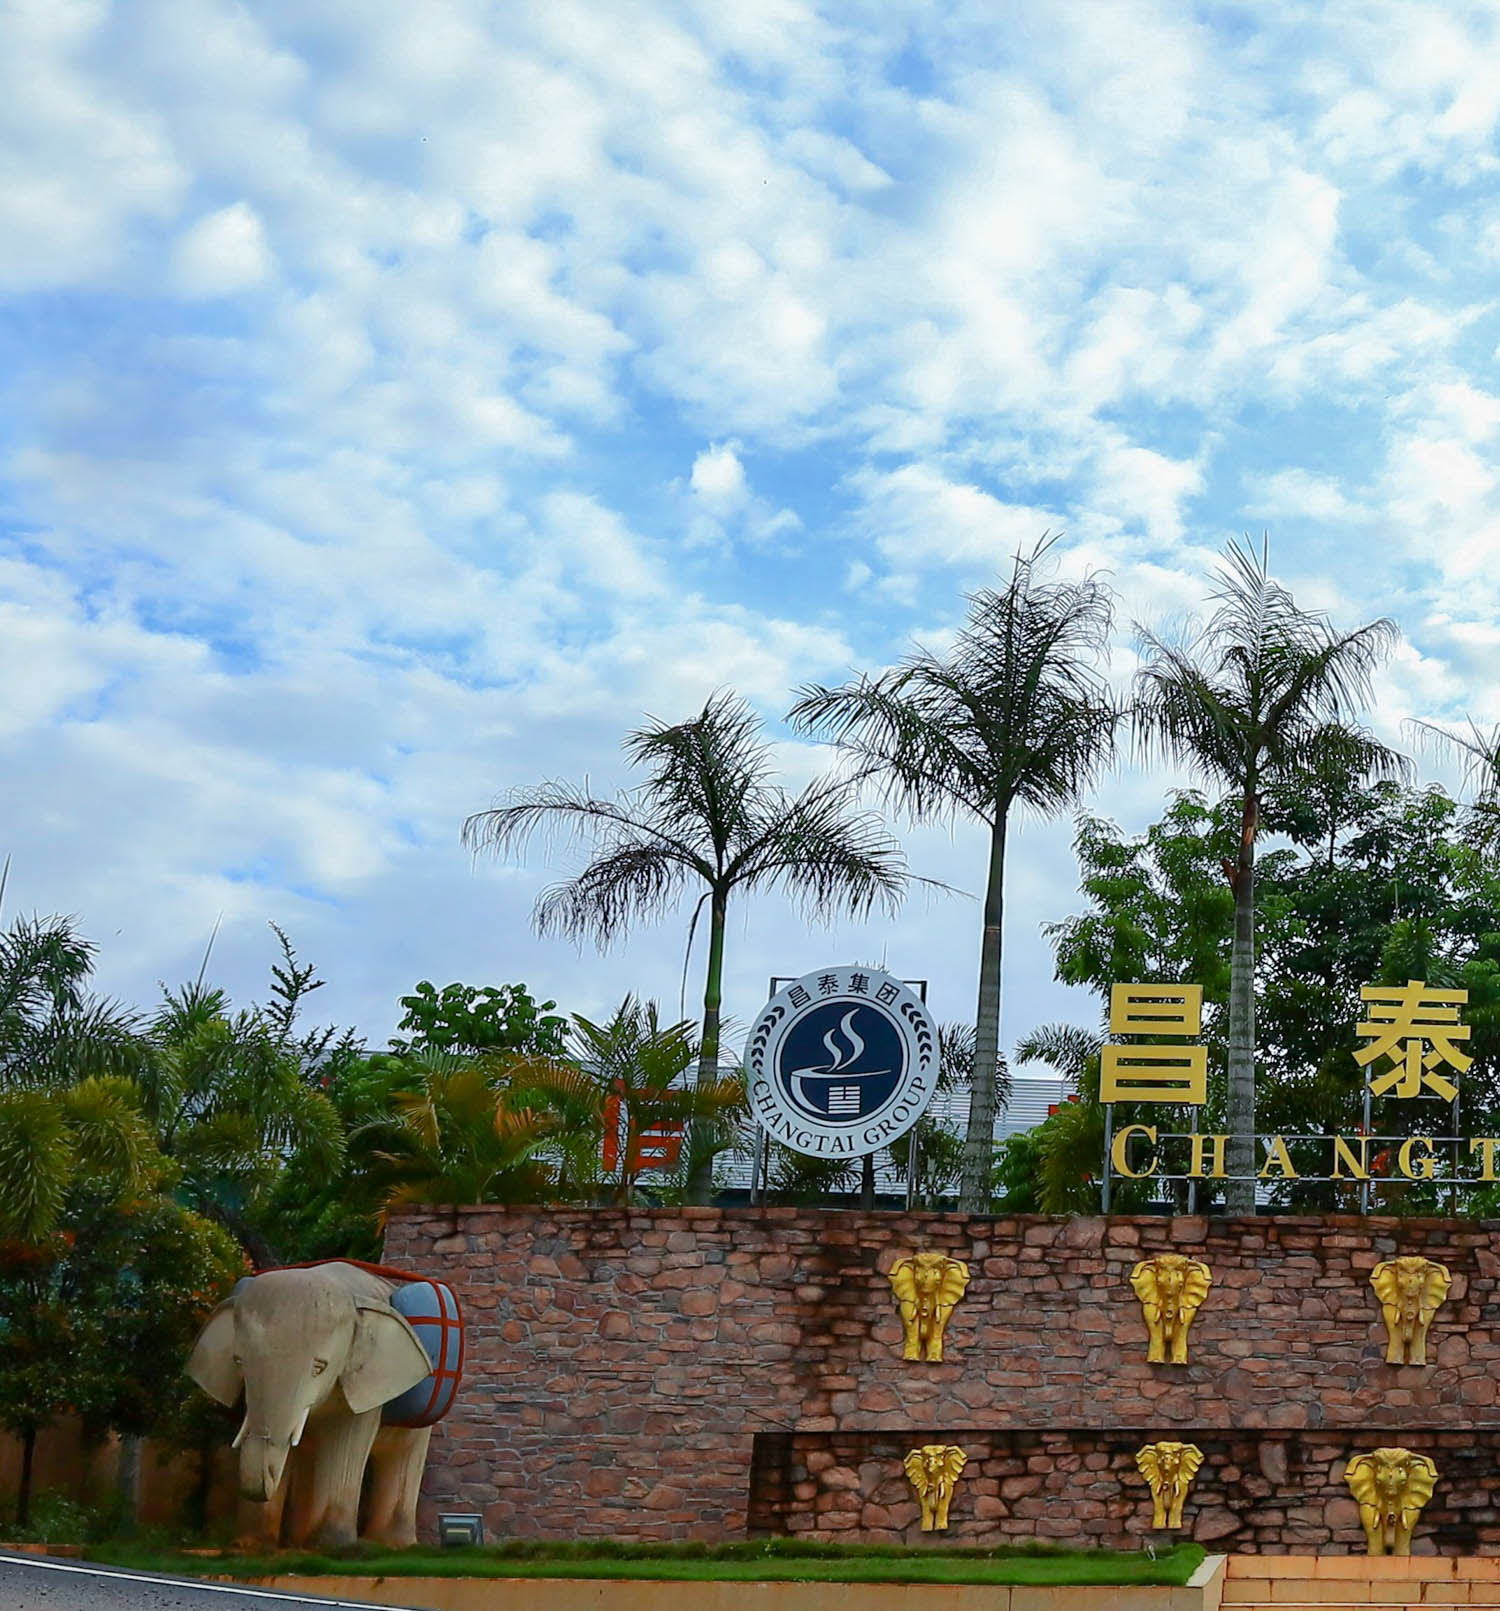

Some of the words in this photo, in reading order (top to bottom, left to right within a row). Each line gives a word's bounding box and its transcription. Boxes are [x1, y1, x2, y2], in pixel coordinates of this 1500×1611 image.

[787, 972, 900, 1009] 昌泰集团
[753, 1079, 856, 1153] CHANGTAI
[863, 1075, 929, 1146] GROUP
